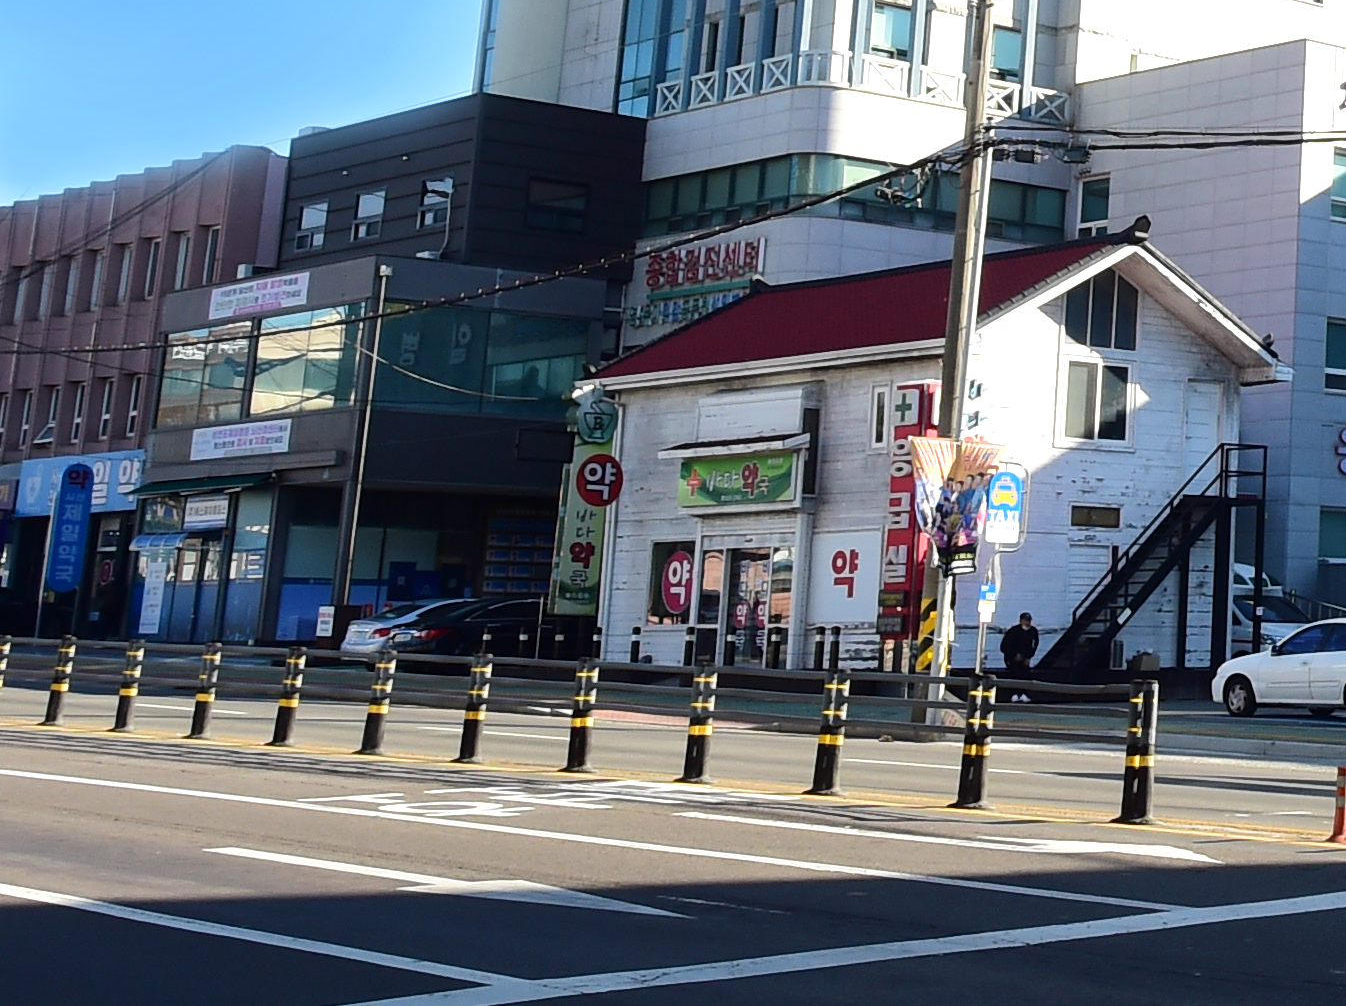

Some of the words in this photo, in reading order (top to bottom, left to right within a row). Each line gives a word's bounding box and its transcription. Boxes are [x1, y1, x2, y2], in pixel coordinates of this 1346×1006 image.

[584, 462, 617, 501] 약
[706, 460, 771, 498] 바다약국
[988, 509, 1020, 522] TAXI
[668, 560, 691, 605] 약
[831, 548, 860, 599] 약
